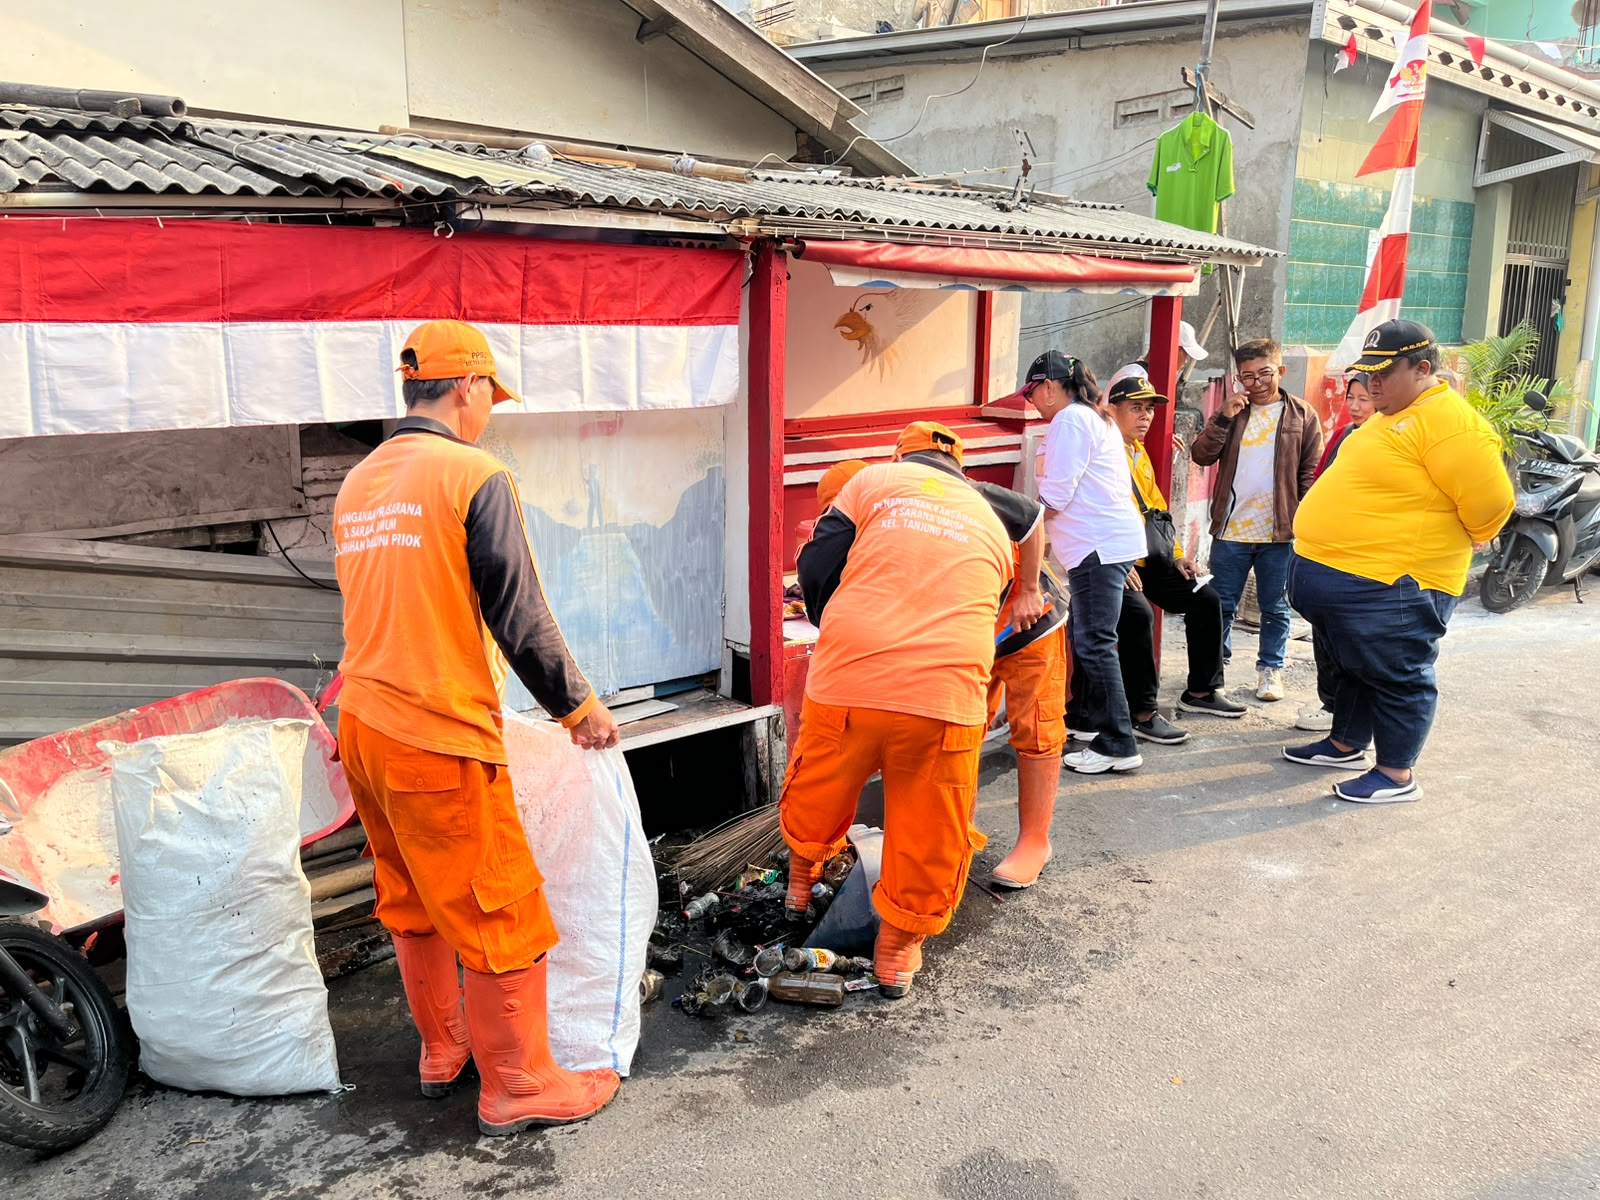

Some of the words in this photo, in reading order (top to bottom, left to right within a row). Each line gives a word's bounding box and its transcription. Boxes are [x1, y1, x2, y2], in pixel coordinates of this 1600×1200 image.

[898, 507, 935, 525] SARANA
[903, 519, 941, 536] TANJUNG
[942, 530, 969, 543] PRIOK
[391, 533, 422, 548] PRIOK
